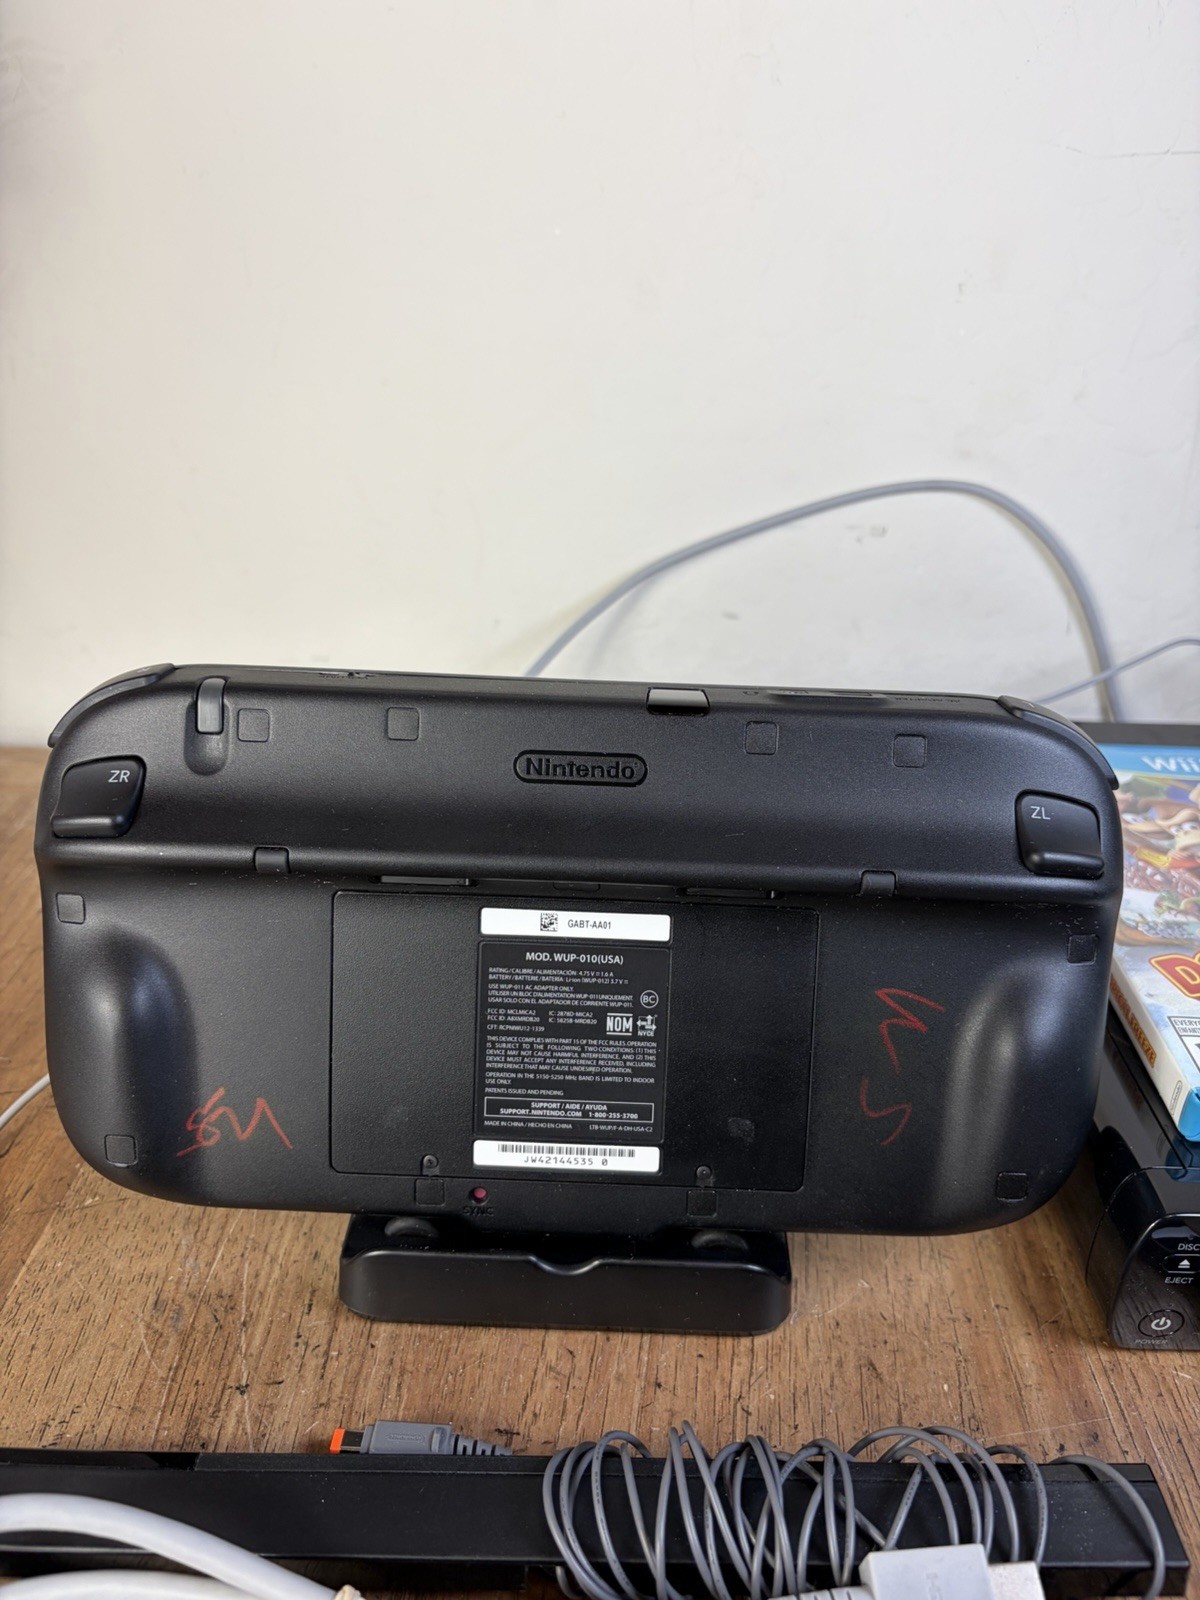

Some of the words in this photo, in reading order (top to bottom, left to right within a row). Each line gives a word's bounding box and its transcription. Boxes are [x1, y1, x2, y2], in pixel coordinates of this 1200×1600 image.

[526, 757, 635, 780] Nintendo
[108, 770, 130, 782] ZR
[1030, 805, 1051, 820] ZL
[567, 919, 612, 930] GABT-AA01
[525, 952, 552, 962] MOD.
[553, 953, 624, 965] WUP-010(USA)
[642, 995, 656, 1004] BC
[606, 1016, 633, 1032] NOM
[500, 1108, 582, 1117] SUPPORT.NINTENDO.COM
[524, 1156, 594, 1166] JW42144535
[1177, 1243, 1200, 1251] DISC
[1164, 1276, 1194, 1284] EJECT
